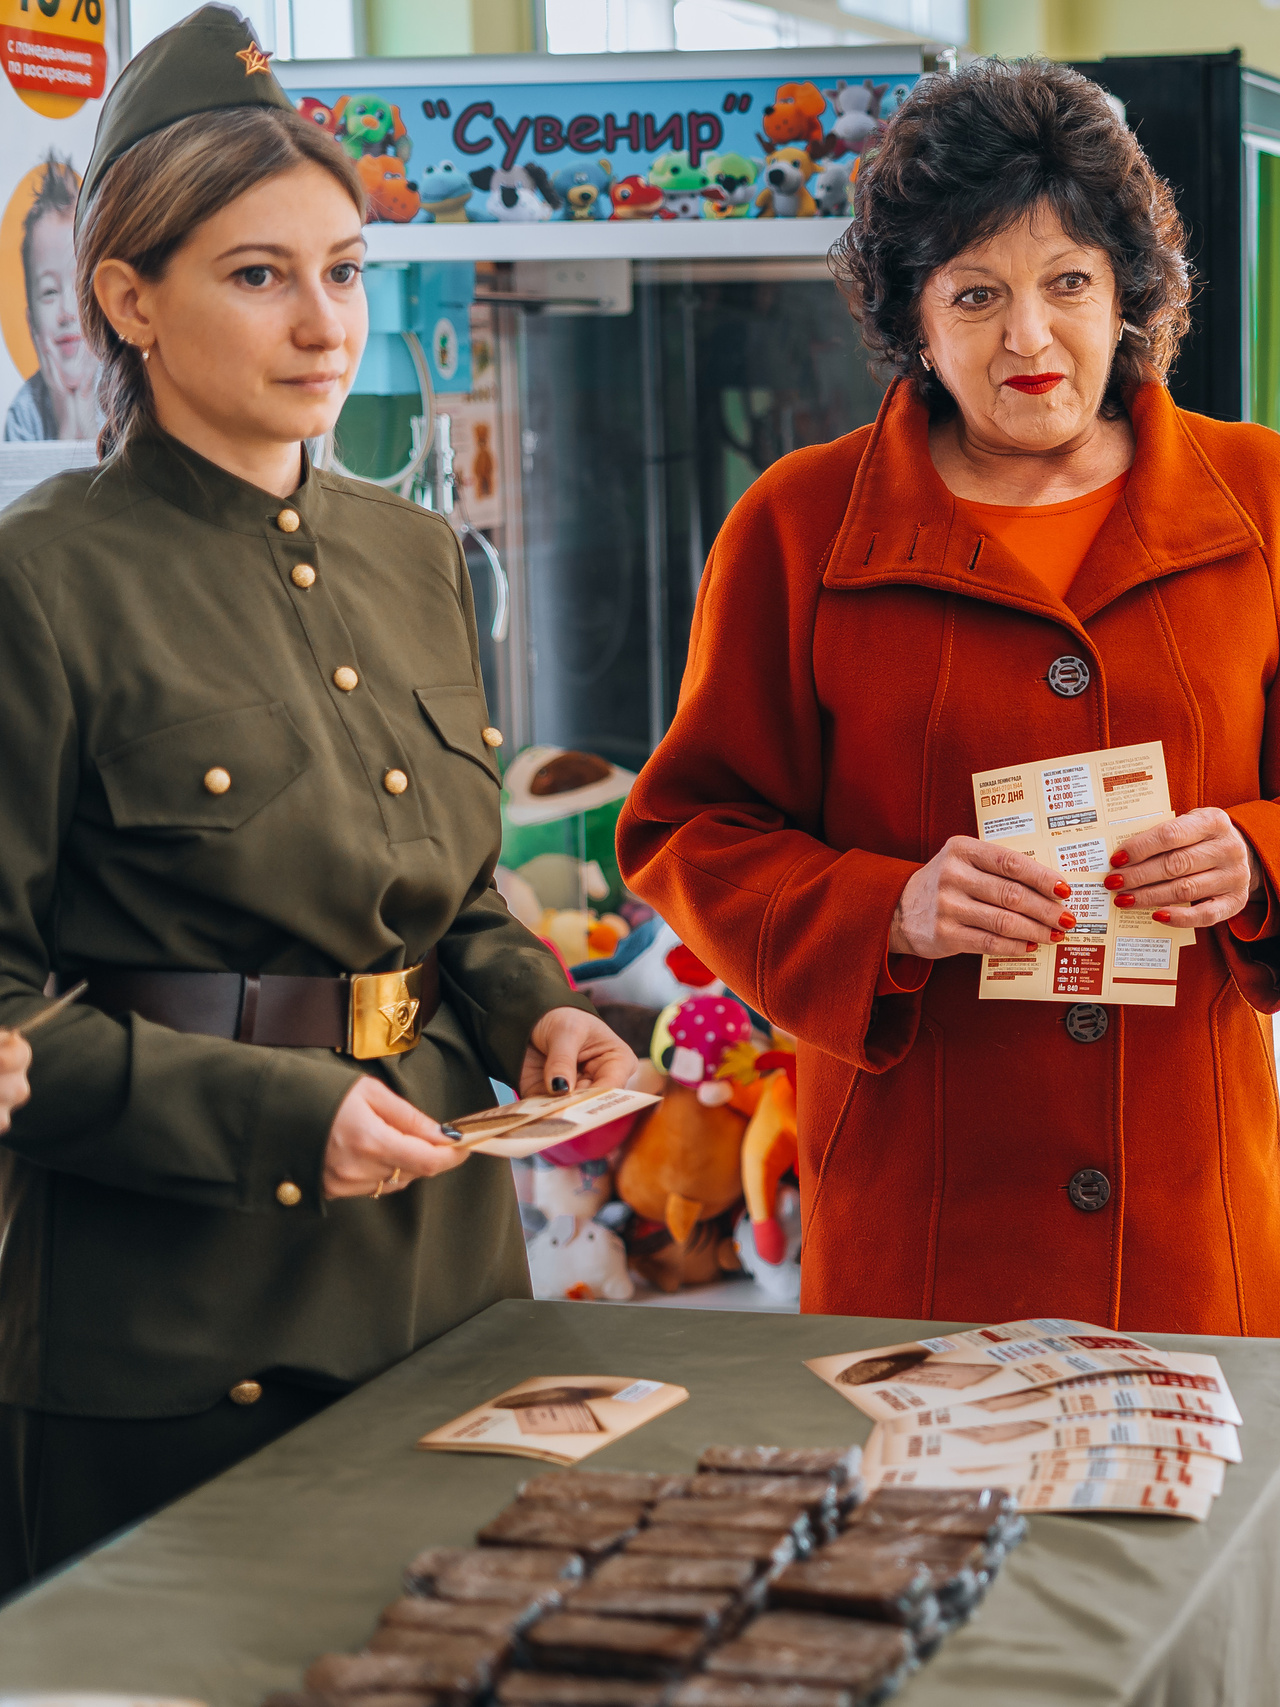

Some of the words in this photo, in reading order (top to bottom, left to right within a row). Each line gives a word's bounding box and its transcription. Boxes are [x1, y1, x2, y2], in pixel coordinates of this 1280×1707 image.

[997, 775, 1022, 785] ЛЕНИНГРАДА
[991, 793, 1006, 806] 872
[1007, 789, 1024, 803] ДНЯ
[1062, 791, 1073, 800] 000
[1065, 800, 1074, 808] 700
[1069, 966, 1080, 974] 610
[1067, 984, 1078, 992] 840
